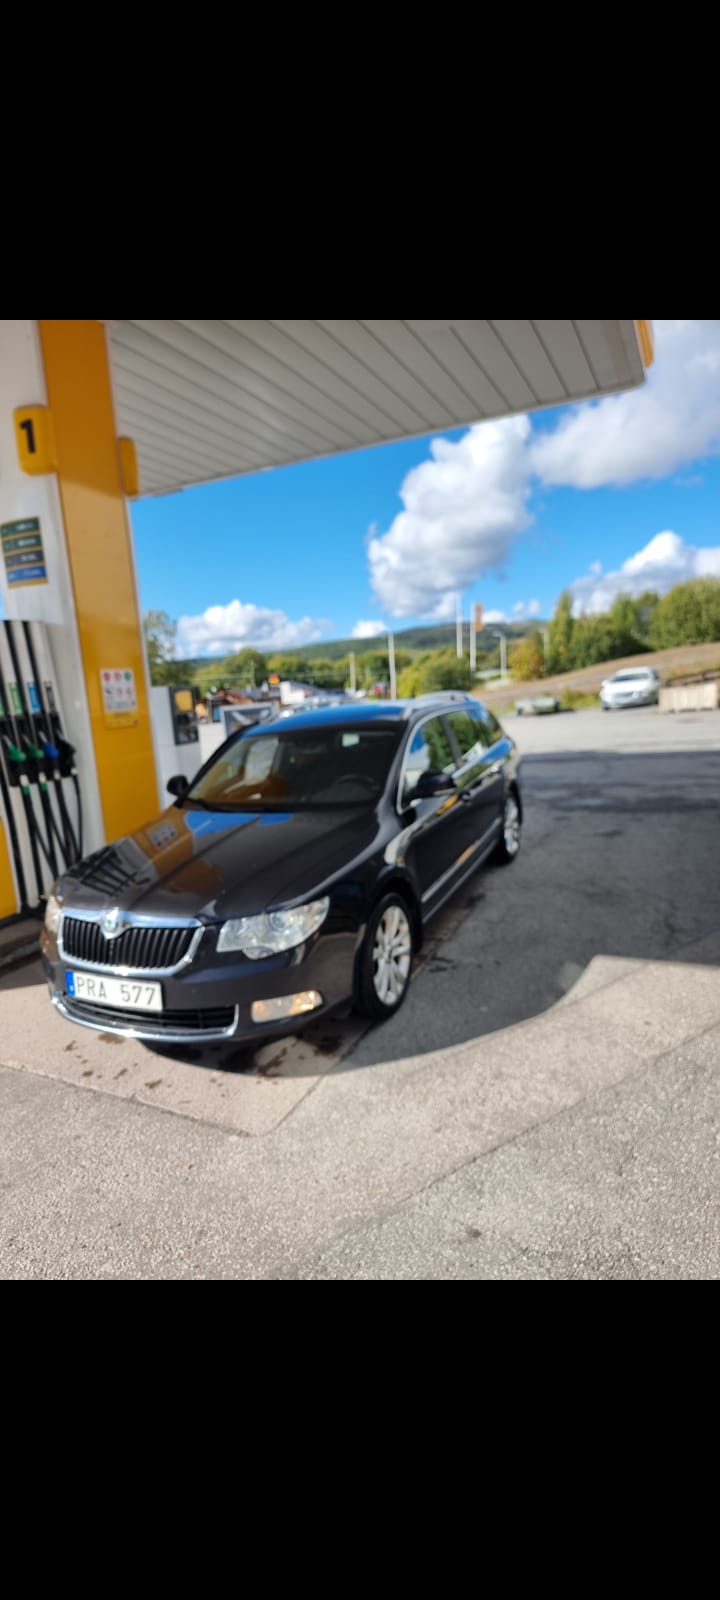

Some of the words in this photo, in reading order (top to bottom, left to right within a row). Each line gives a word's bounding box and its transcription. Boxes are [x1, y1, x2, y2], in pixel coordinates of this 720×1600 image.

[19, 418, 36, 454] 1
[76, 976, 107, 998] PRA
[120, 984, 156, 1006] 577
